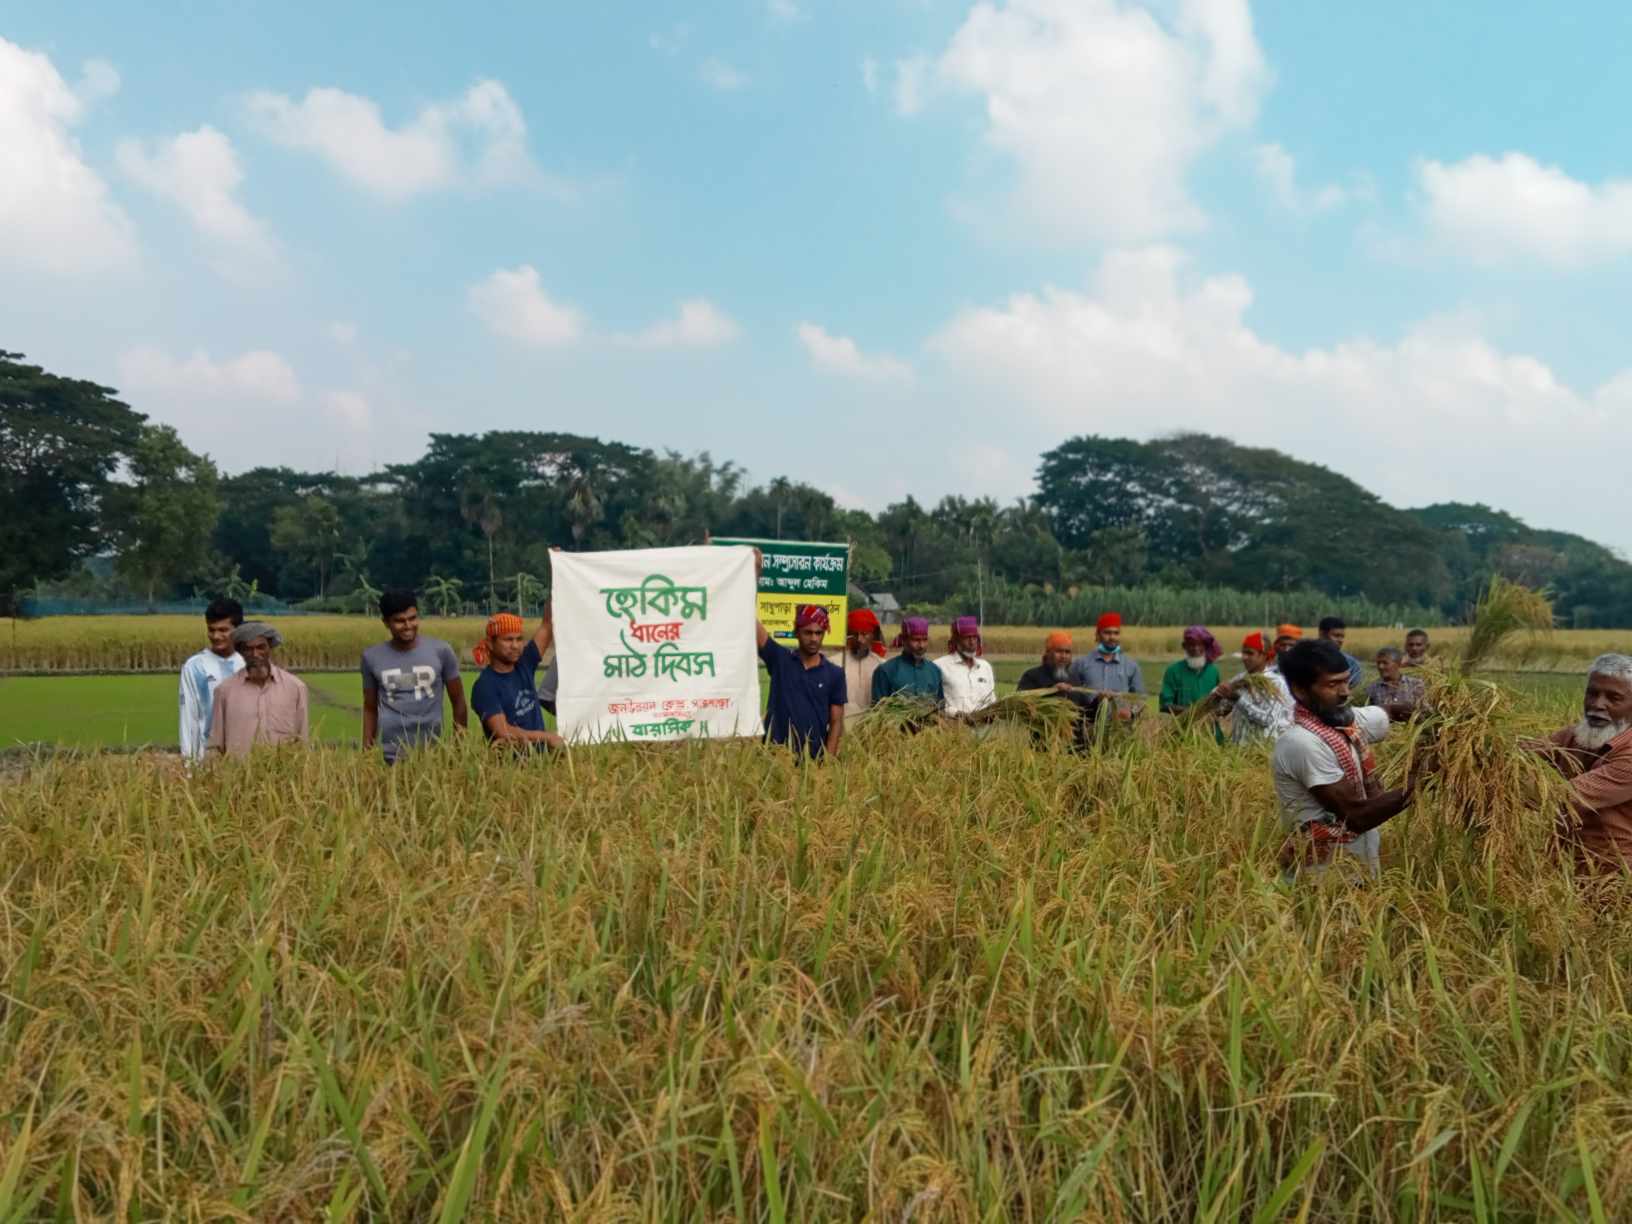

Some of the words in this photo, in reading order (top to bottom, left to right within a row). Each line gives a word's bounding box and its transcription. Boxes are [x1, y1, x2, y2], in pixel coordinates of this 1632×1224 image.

[599, 574, 707, 621] হেকিম
[629, 618, 683, 643] ধানের
[603, 629, 647, 678] মাঠ
[654, 642, 716, 682] দিবস
